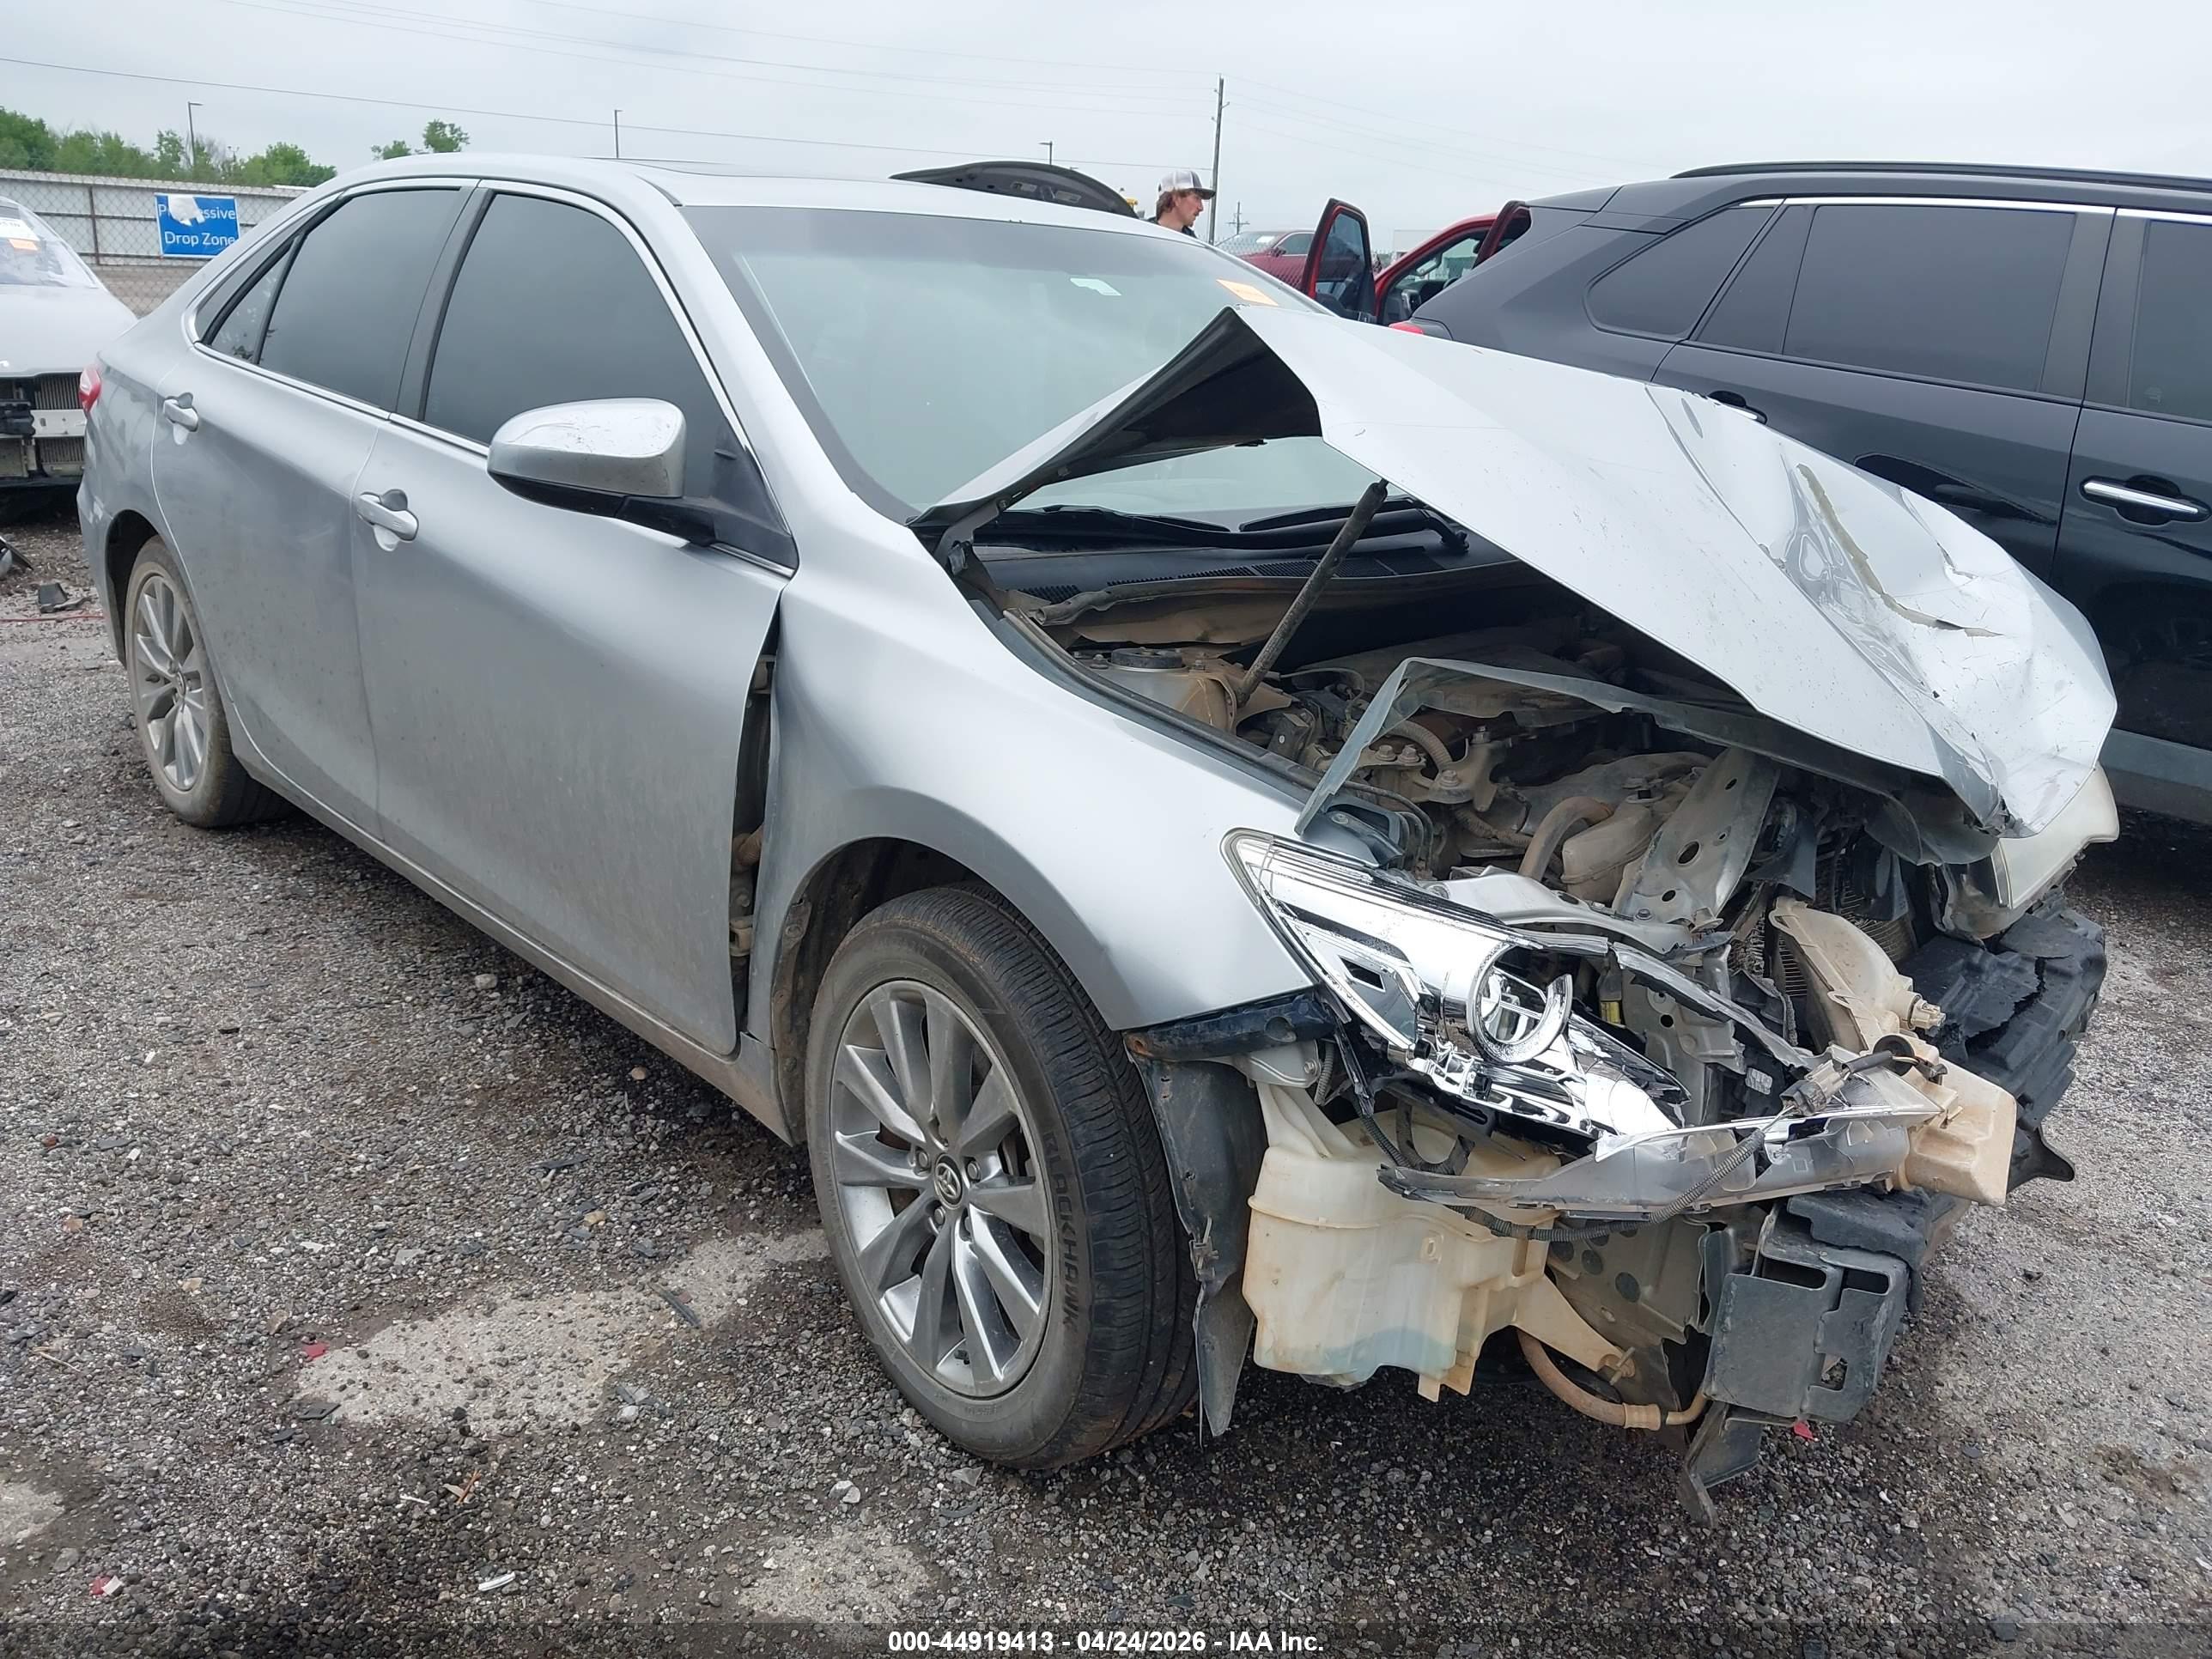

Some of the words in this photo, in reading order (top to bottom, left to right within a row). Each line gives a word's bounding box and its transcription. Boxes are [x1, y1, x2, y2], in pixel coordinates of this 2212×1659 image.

[157, 204, 236, 220] Pssive
[164, 230, 199, 248] Drop
[201, 232, 236, 247] Zone
[1042, 1131, 1080, 1334] BLACKHAWK
